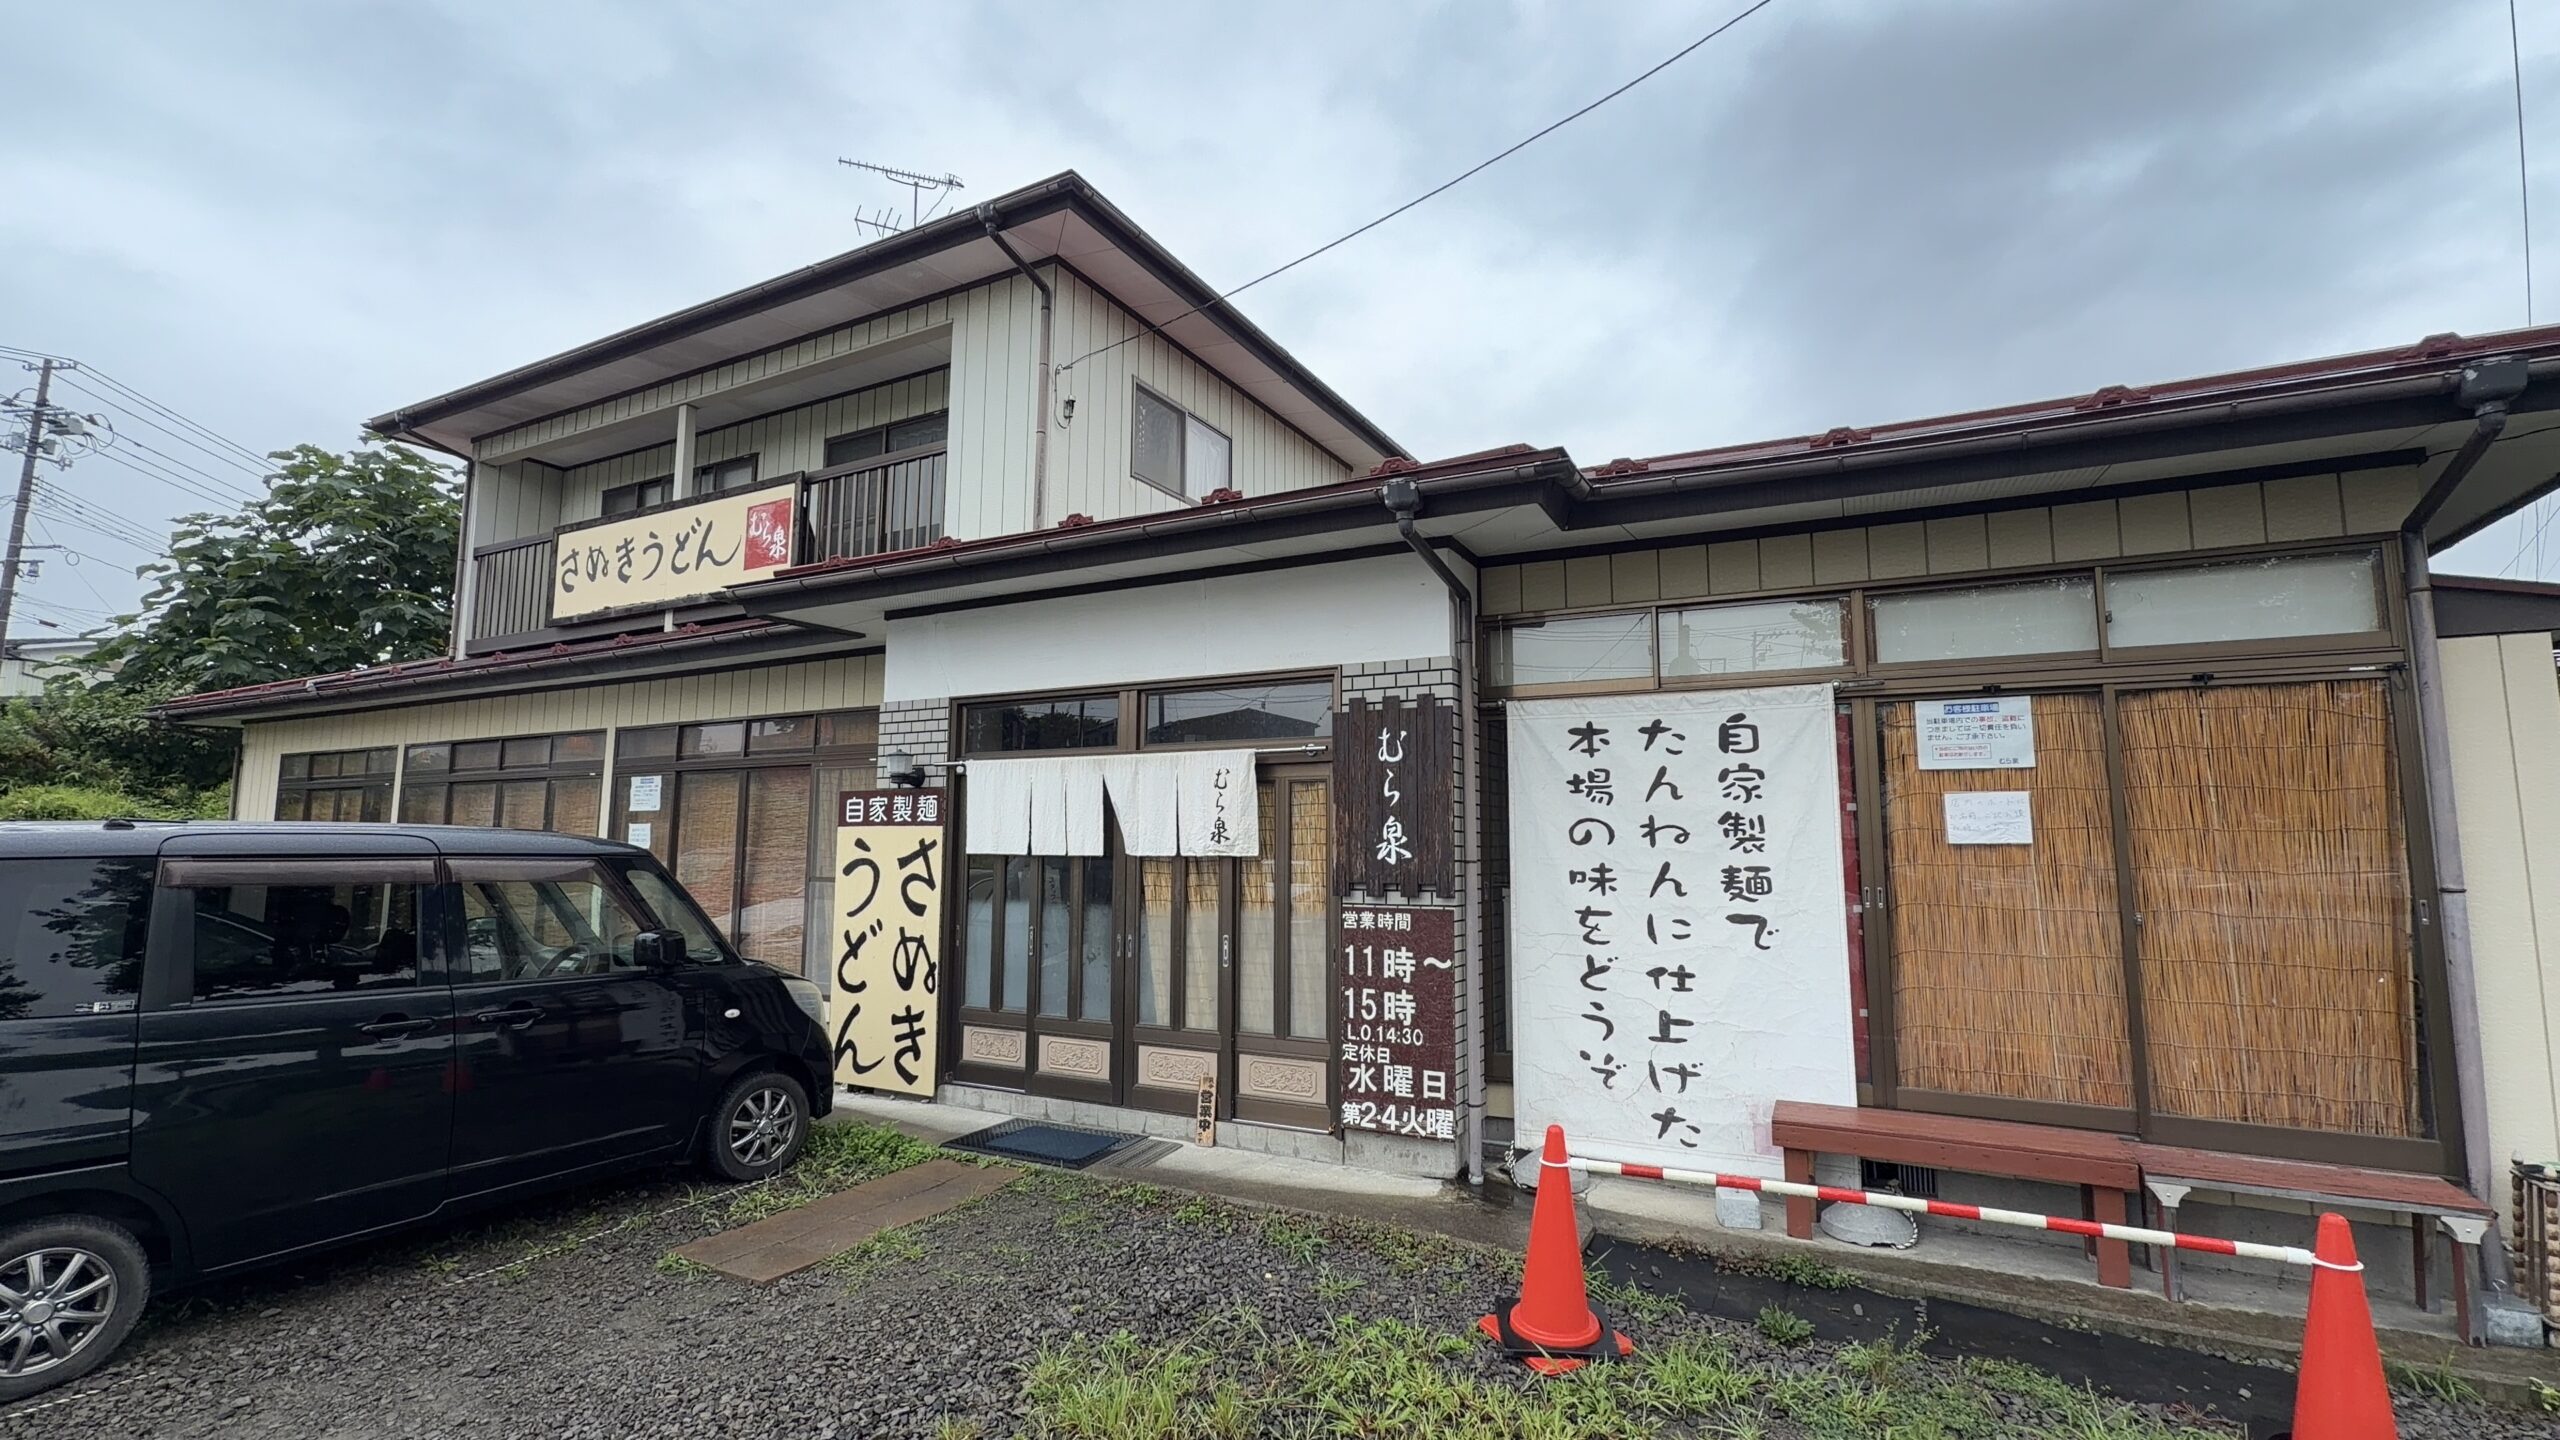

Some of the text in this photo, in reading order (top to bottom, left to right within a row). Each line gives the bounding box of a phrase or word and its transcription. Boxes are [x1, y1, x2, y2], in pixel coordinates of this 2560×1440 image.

[561, 516, 742, 593] さぬきうどん
[749, 511, 787, 559] むら泉
[846, 796, 938, 823] 自家製麺
[1210, 768, 1231, 845] むら泉
[1376, 727, 1413, 865] むら泉
[1717, 713, 1780, 951] 自家製麺で
[1342, 911, 1412, 932] 営業時間
[1566, 721, 1628, 1090] 本場の味をどうぞ
[1638, 719, 1704, 1148] たんねんに仕上げた
[834, 838, 886, 1075] うどん
[893, 838, 938, 1086] さぬき
[1345, 987, 1417, 1027] 15時
[1347, 1024, 1424, 1046] L.O.14:30
[1342, 1043, 1391, 1064] 定休日
[1347, 1063, 1447, 1101] 水曜日
[1199, 1089, 1213, 1132] 営業中
